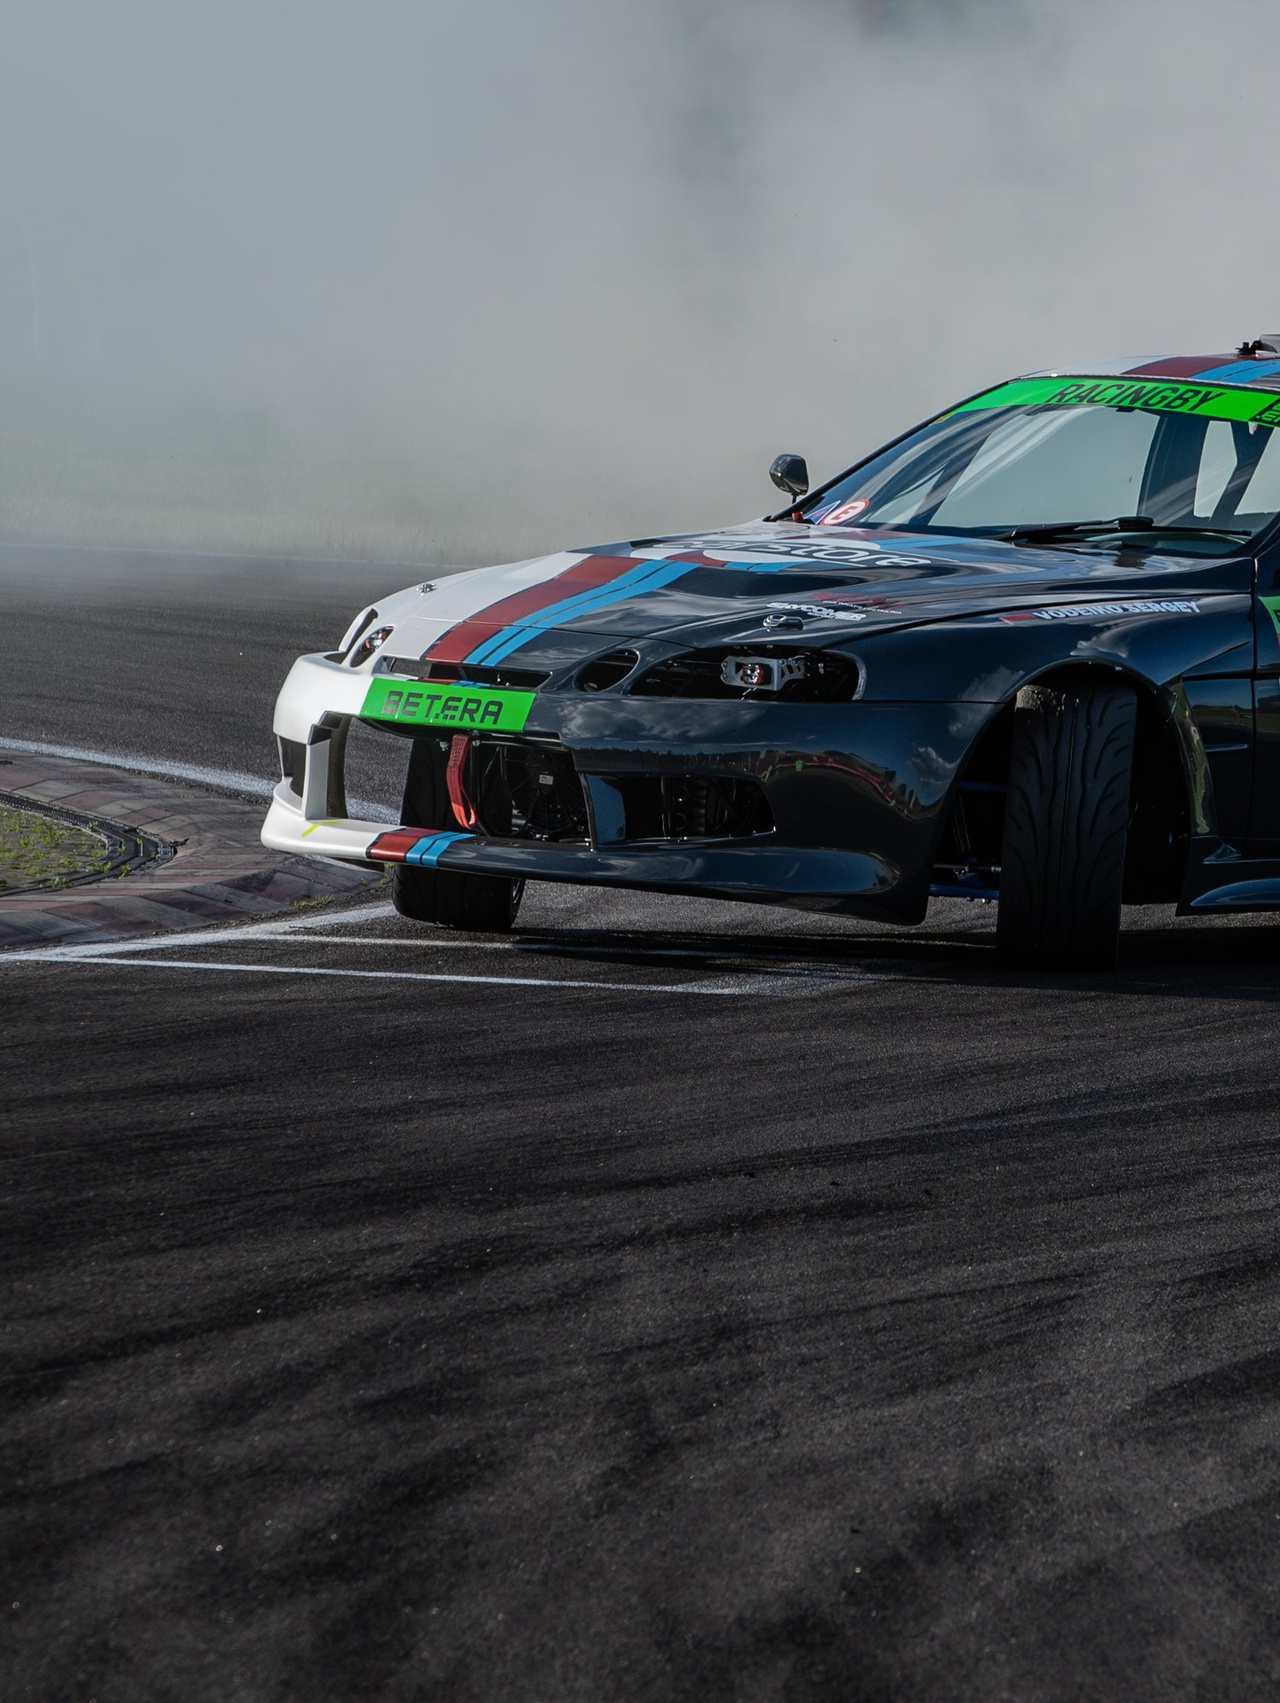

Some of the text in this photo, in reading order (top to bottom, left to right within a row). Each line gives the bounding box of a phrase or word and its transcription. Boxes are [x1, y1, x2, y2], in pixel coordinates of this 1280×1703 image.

[653, 540, 932, 566] carstore
[1032, 601, 1201, 620] VODEIKO SERGEY
